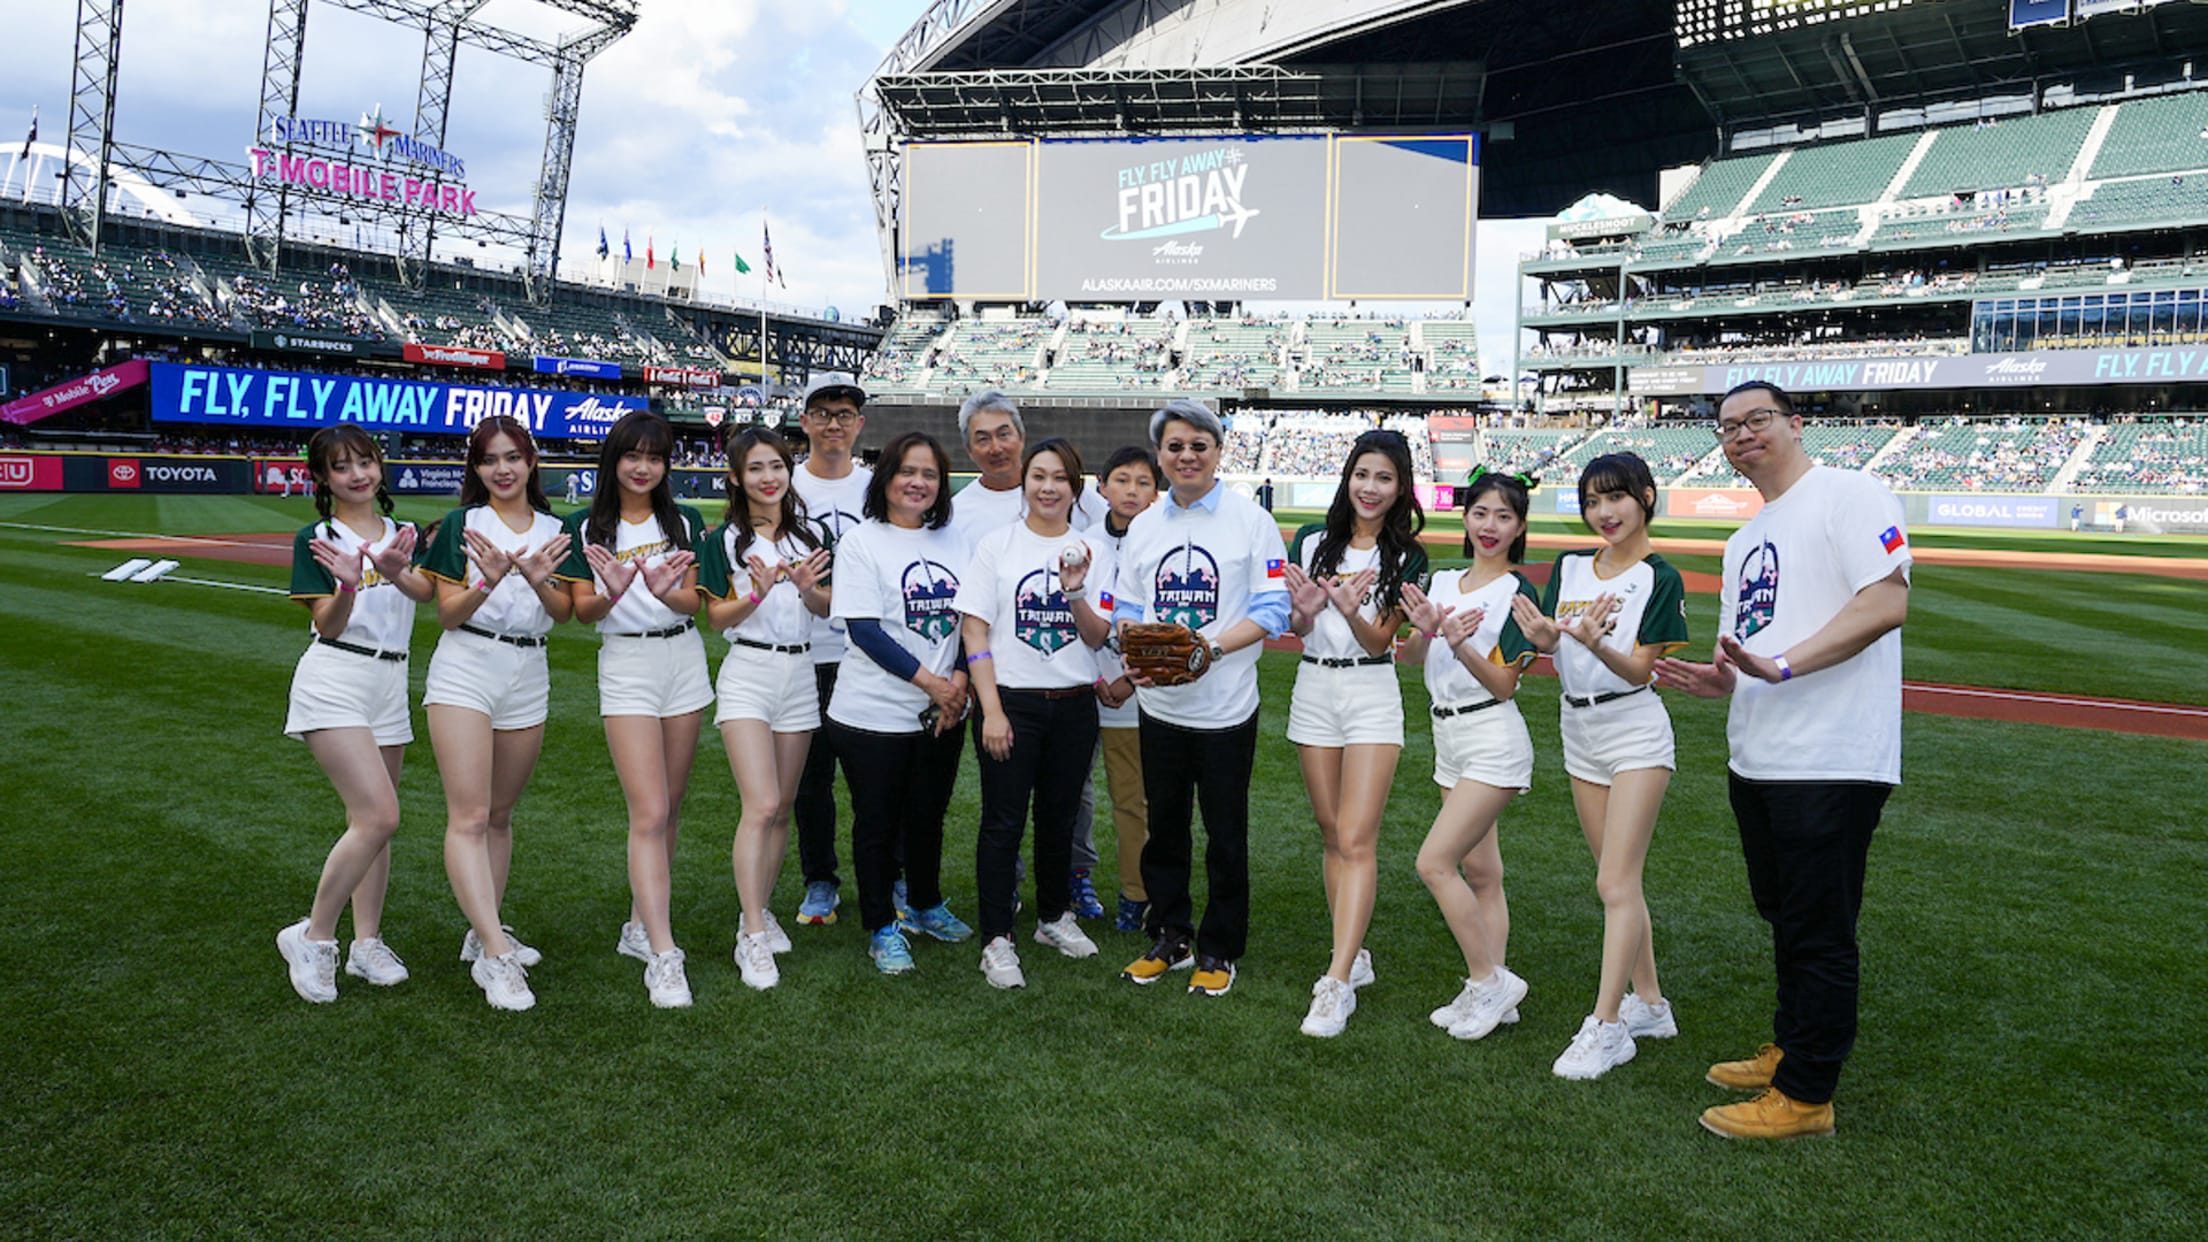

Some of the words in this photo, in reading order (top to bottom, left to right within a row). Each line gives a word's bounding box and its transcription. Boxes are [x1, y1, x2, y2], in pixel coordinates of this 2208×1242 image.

[273, 115, 350, 144] SEATTLE
[394, 133, 466, 179] MARINERS
[1150, 158, 1178, 182] FLY
[1181, 148, 1226, 176] AWAY
[249, 148, 397, 201] T-MOBILE
[404, 177, 478, 216] PARK
[1118, 163, 1248, 233] FRIDAY
[1152, 240, 1205, 257] Alaska
[290, 338, 354, 352] STARBUCKS
[1763, 366, 1800, 387] FLY
[1801, 363, 1858, 387] AWAY
[1862, 361, 1938, 385] FRIDAY
[1985, 357, 2048, 374] Alaska
[2146, 350, 2197, 377] FLY
[180, 369, 253, 418] FLY,
[264, 375, 336, 420] FLY
[340, 381, 438, 425] AWAY
[445, 388, 552, 432] FRIDAY
[146, 466, 217, 481] TOYOTA
[1937, 504, 2011, 518] GLOBAL
[907, 598, 954, 611] TAIWA
[1159, 590, 1215, 603] TAIWAN
